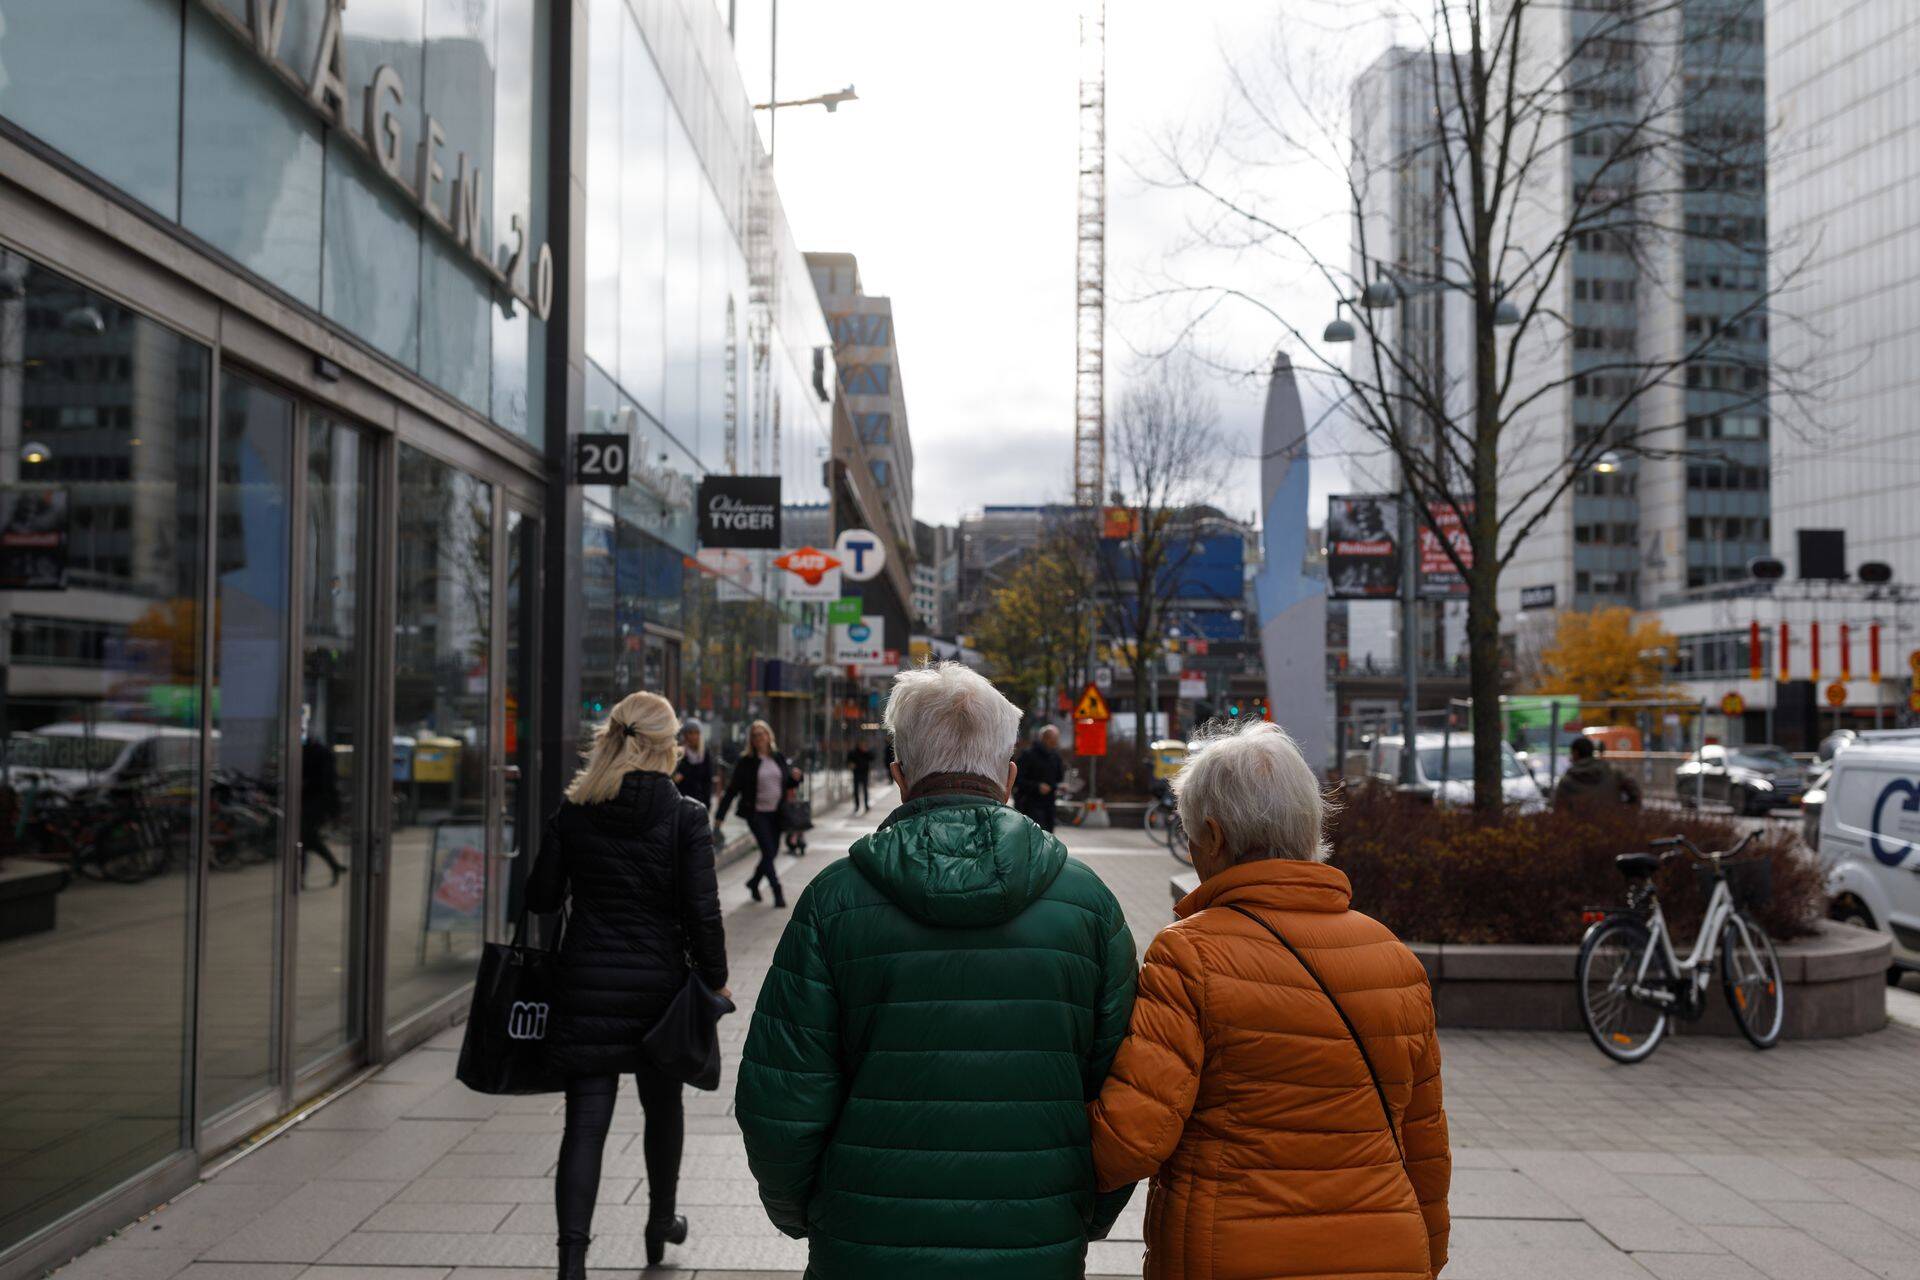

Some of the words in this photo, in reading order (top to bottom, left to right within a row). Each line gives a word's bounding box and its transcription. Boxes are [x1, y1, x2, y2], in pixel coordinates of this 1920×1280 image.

[505, 213, 554, 321] 20
[581, 444, 624, 474] 20
[709, 512, 775, 530] TYGER
[846, 541, 874, 572] T
